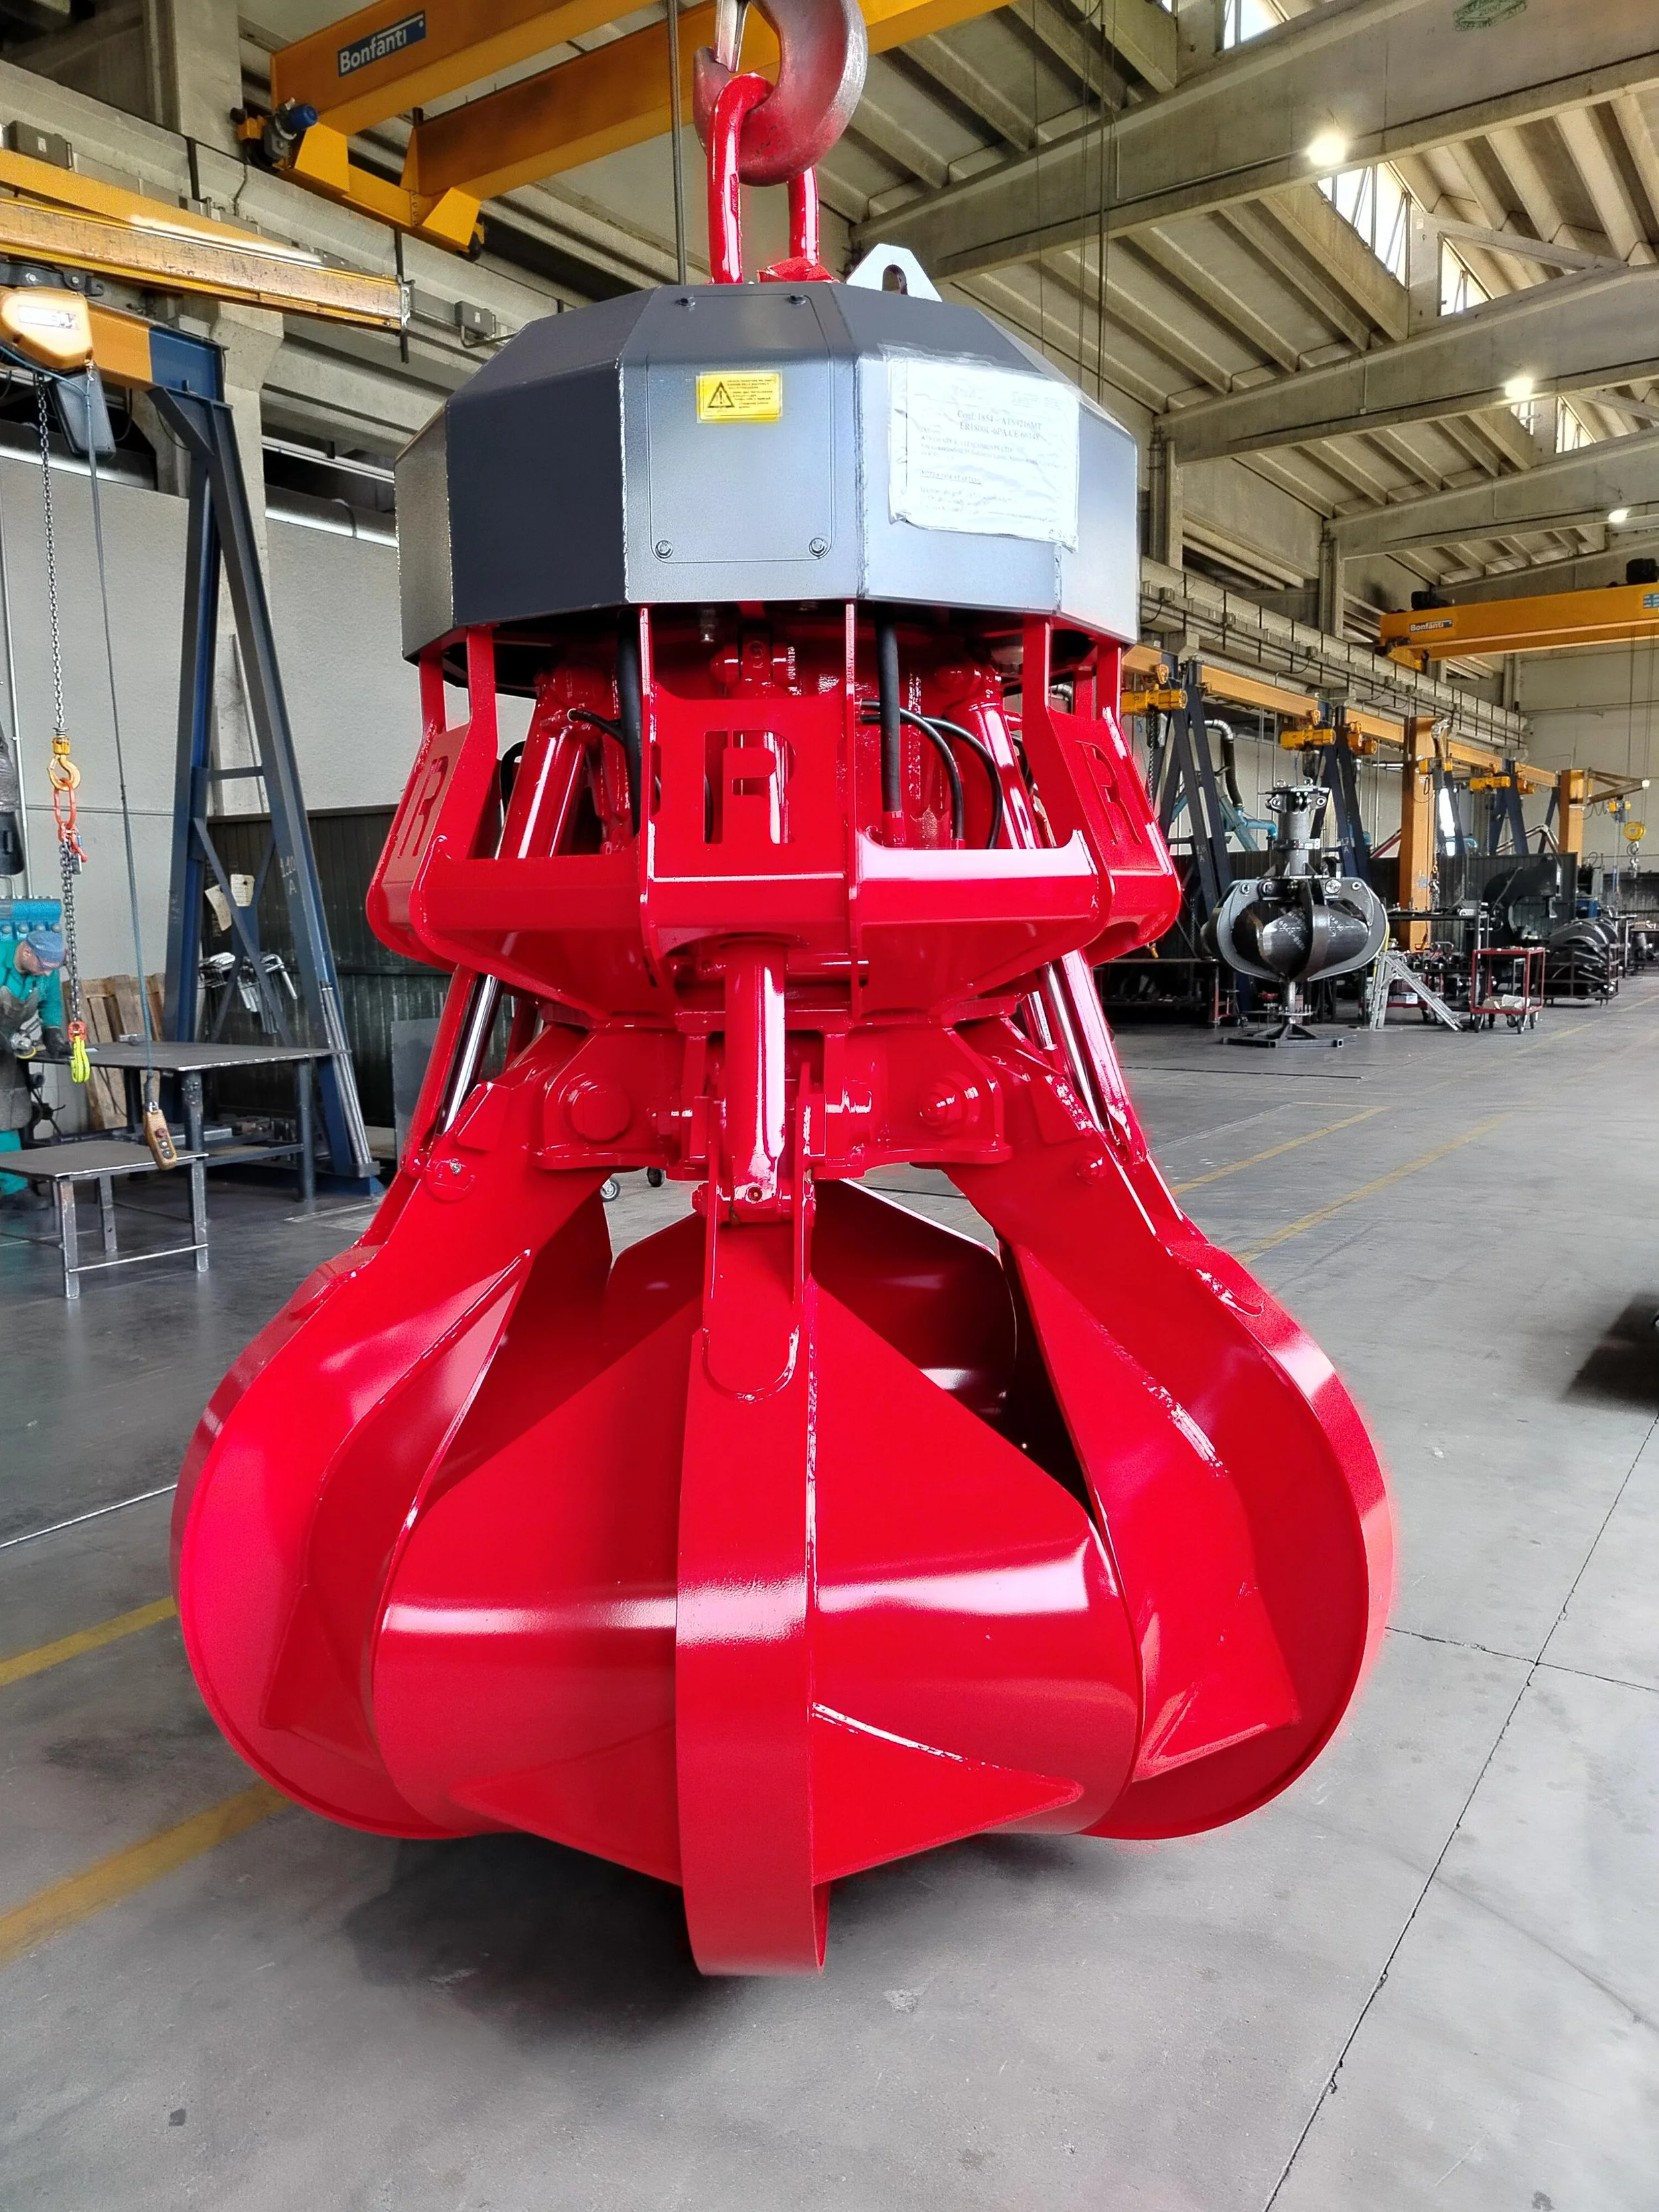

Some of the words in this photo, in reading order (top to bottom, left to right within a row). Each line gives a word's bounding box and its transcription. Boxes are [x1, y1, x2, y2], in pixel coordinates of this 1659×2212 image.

[340, 29, 407, 73] Bonfanti
[1410, 622, 1444, 632] Bonfanti
[703, 729, 796, 845] R
[289, 879, 298, 895] A
